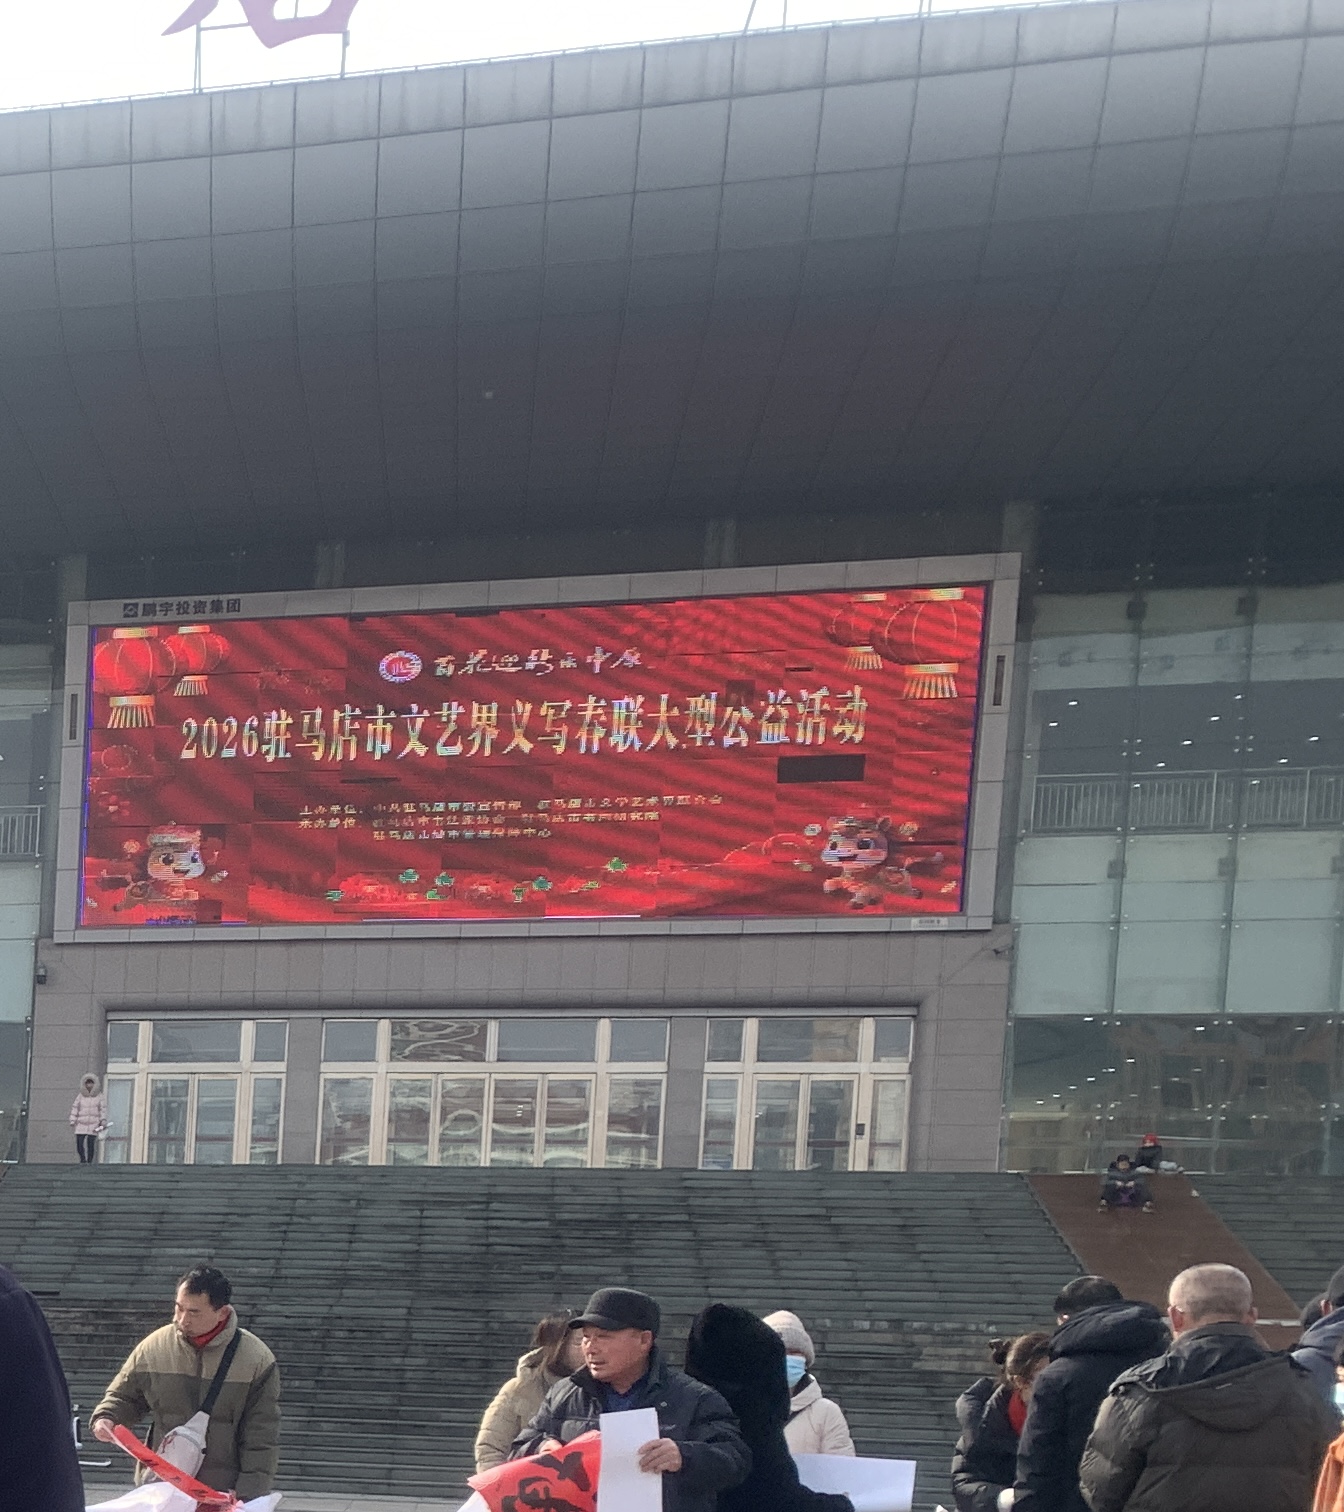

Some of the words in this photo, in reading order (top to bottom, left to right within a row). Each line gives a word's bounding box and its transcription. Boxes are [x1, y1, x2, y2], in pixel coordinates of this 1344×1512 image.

[179, 684, 868, 763] 2026驻马店市文艺界义写春联大型公益活动
